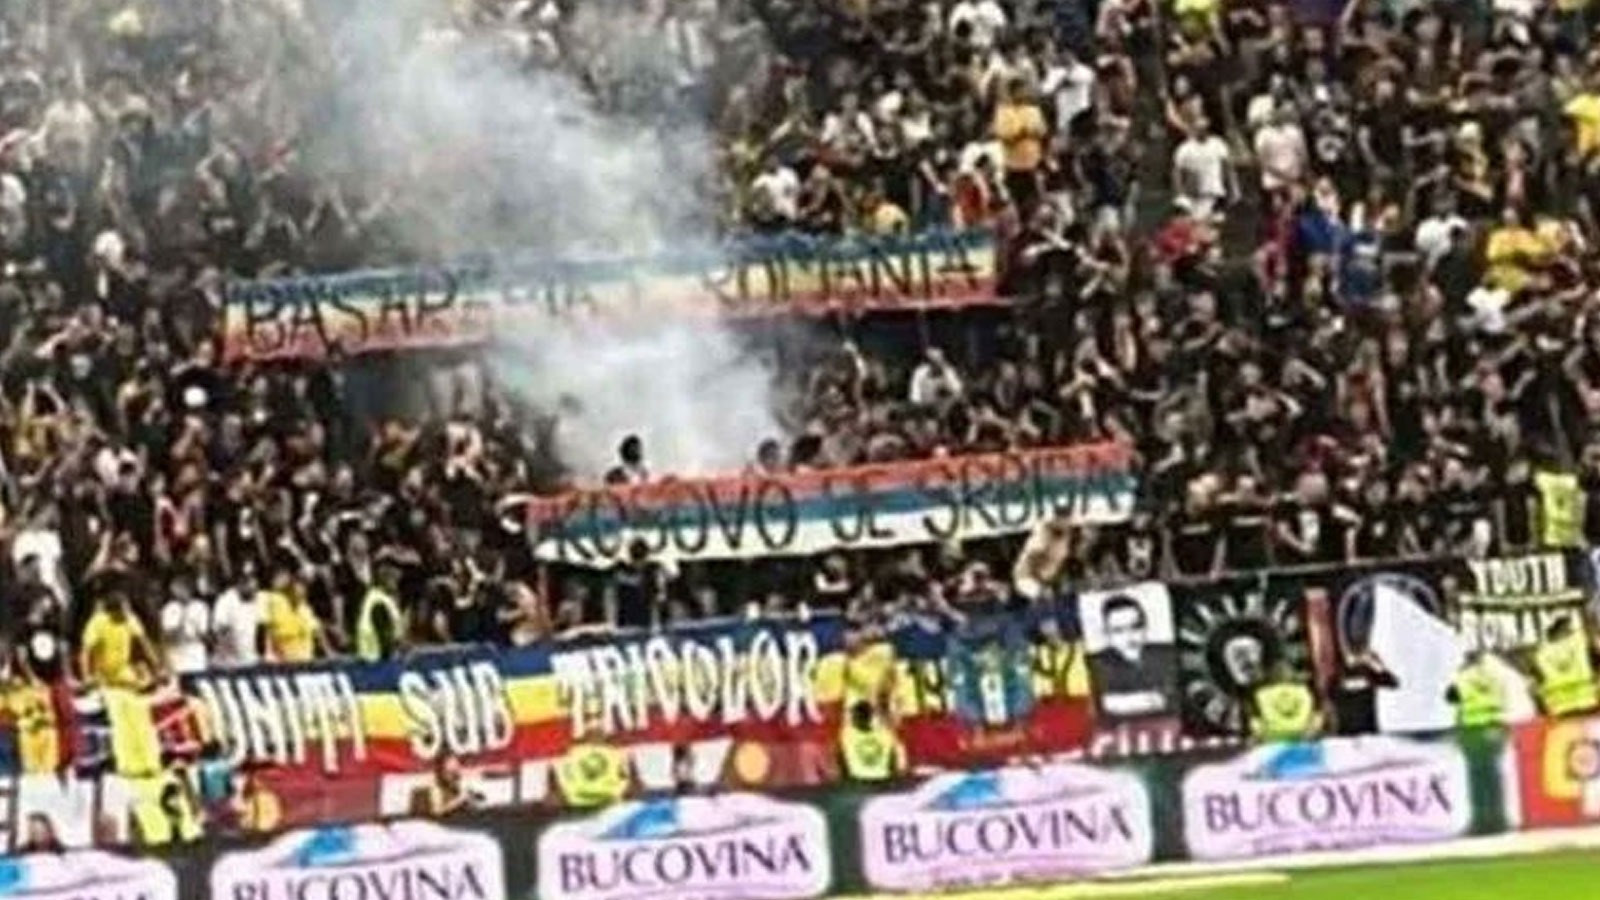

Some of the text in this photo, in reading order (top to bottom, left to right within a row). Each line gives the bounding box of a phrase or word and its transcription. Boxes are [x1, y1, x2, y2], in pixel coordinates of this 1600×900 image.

[557, 478, 798, 559] KOSOVO
[1466, 553, 1567, 596] YOUTH
[402, 661, 514, 759] SUB
[551, 629, 823, 738] TRICOLOR
[1204, 771, 1453, 833] BUCOVINA
[559, 833, 811, 893] BUCOVINA
[883, 805, 1133, 864] BUCOVINA
